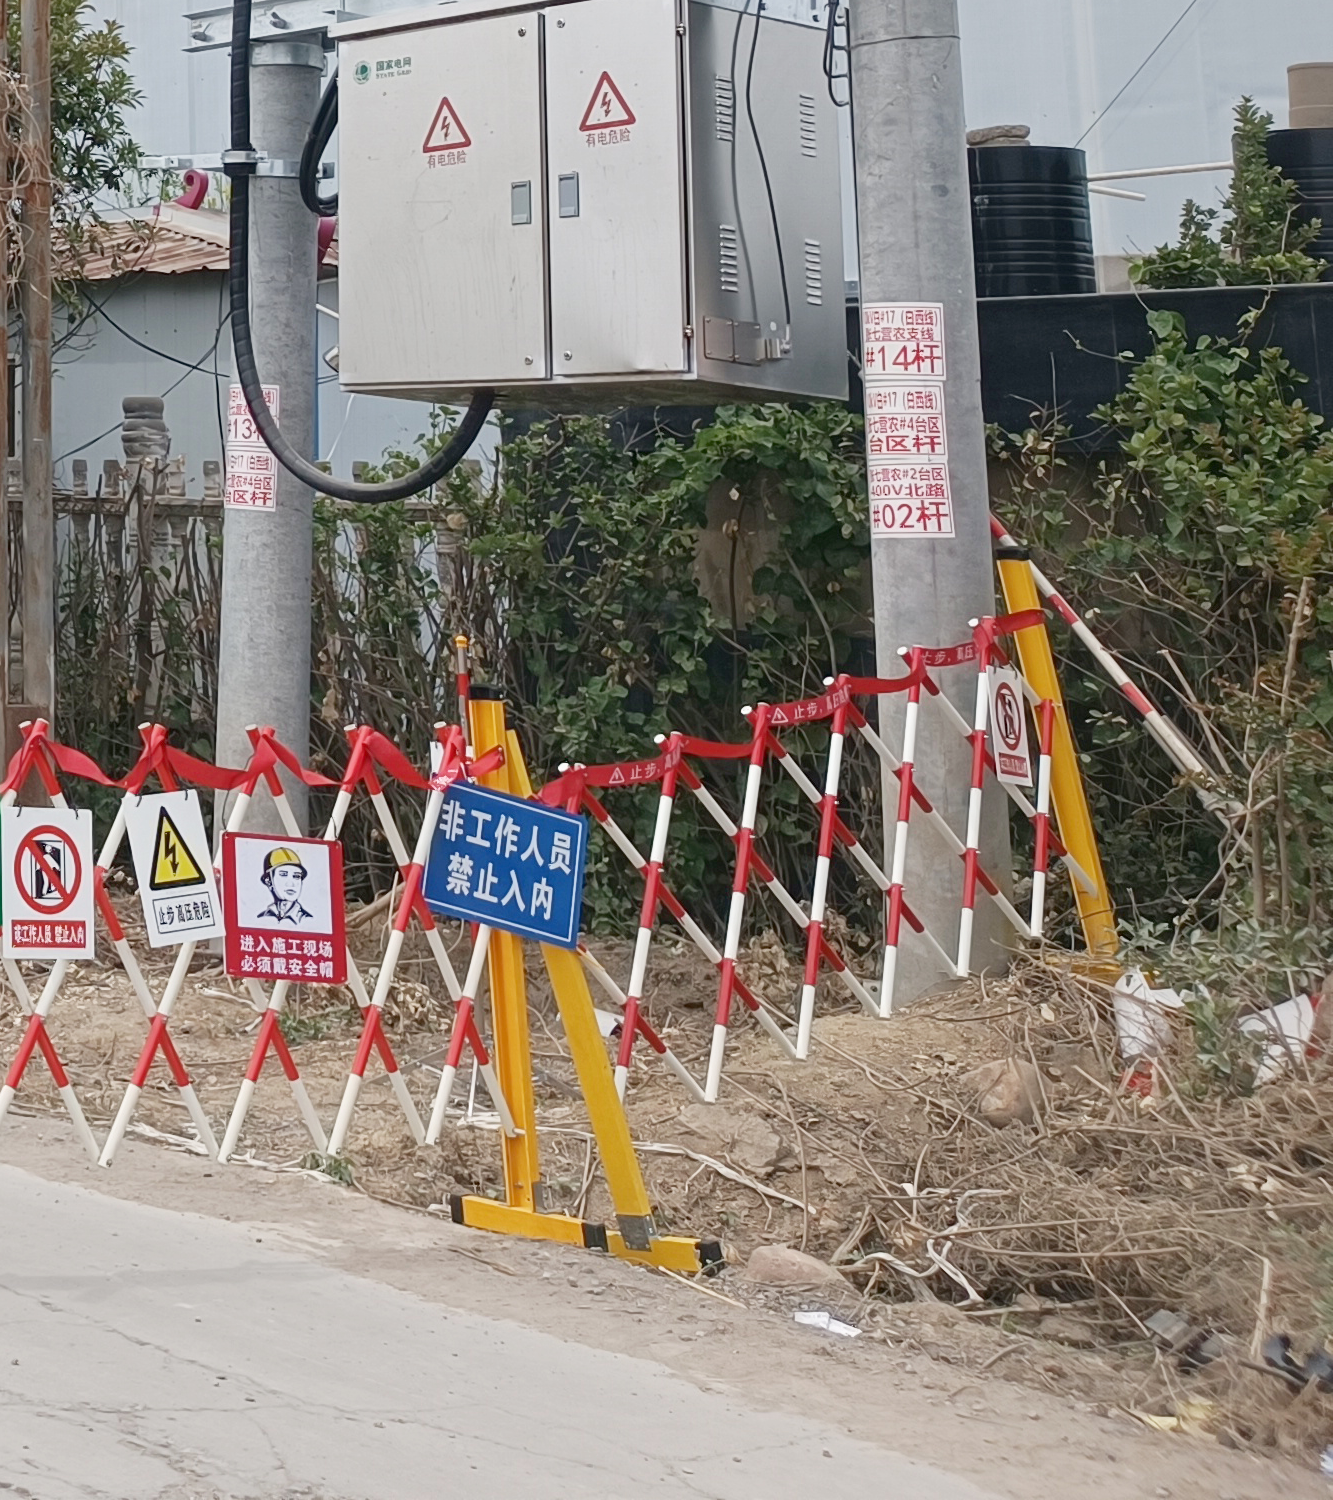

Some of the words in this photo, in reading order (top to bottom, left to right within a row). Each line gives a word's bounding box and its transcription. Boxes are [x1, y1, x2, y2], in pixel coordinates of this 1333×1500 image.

[376, 56, 412, 72] 国家电网
[586, 128, 632, 148] 有电危险
[427, 150, 468, 169] 有电危险
[866, 342, 942, 374] #14杆
[869, 435, 942, 454] 台区杆
[873, 499, 949, 532] #02杆
[439, 799, 572, 875] 非工作人员
[445, 851, 554, 921] 禁止入内
[158, 904, 175, 926] 止步
[175, 900, 212, 923] 高压危险
[13, 924, 52, 944] 非工作人员
[54, 924, 85, 945] 禁止入内
[240, 934, 333, 959] 进入施工现场
[240, 955, 334, 978] 必须戴安全帽
